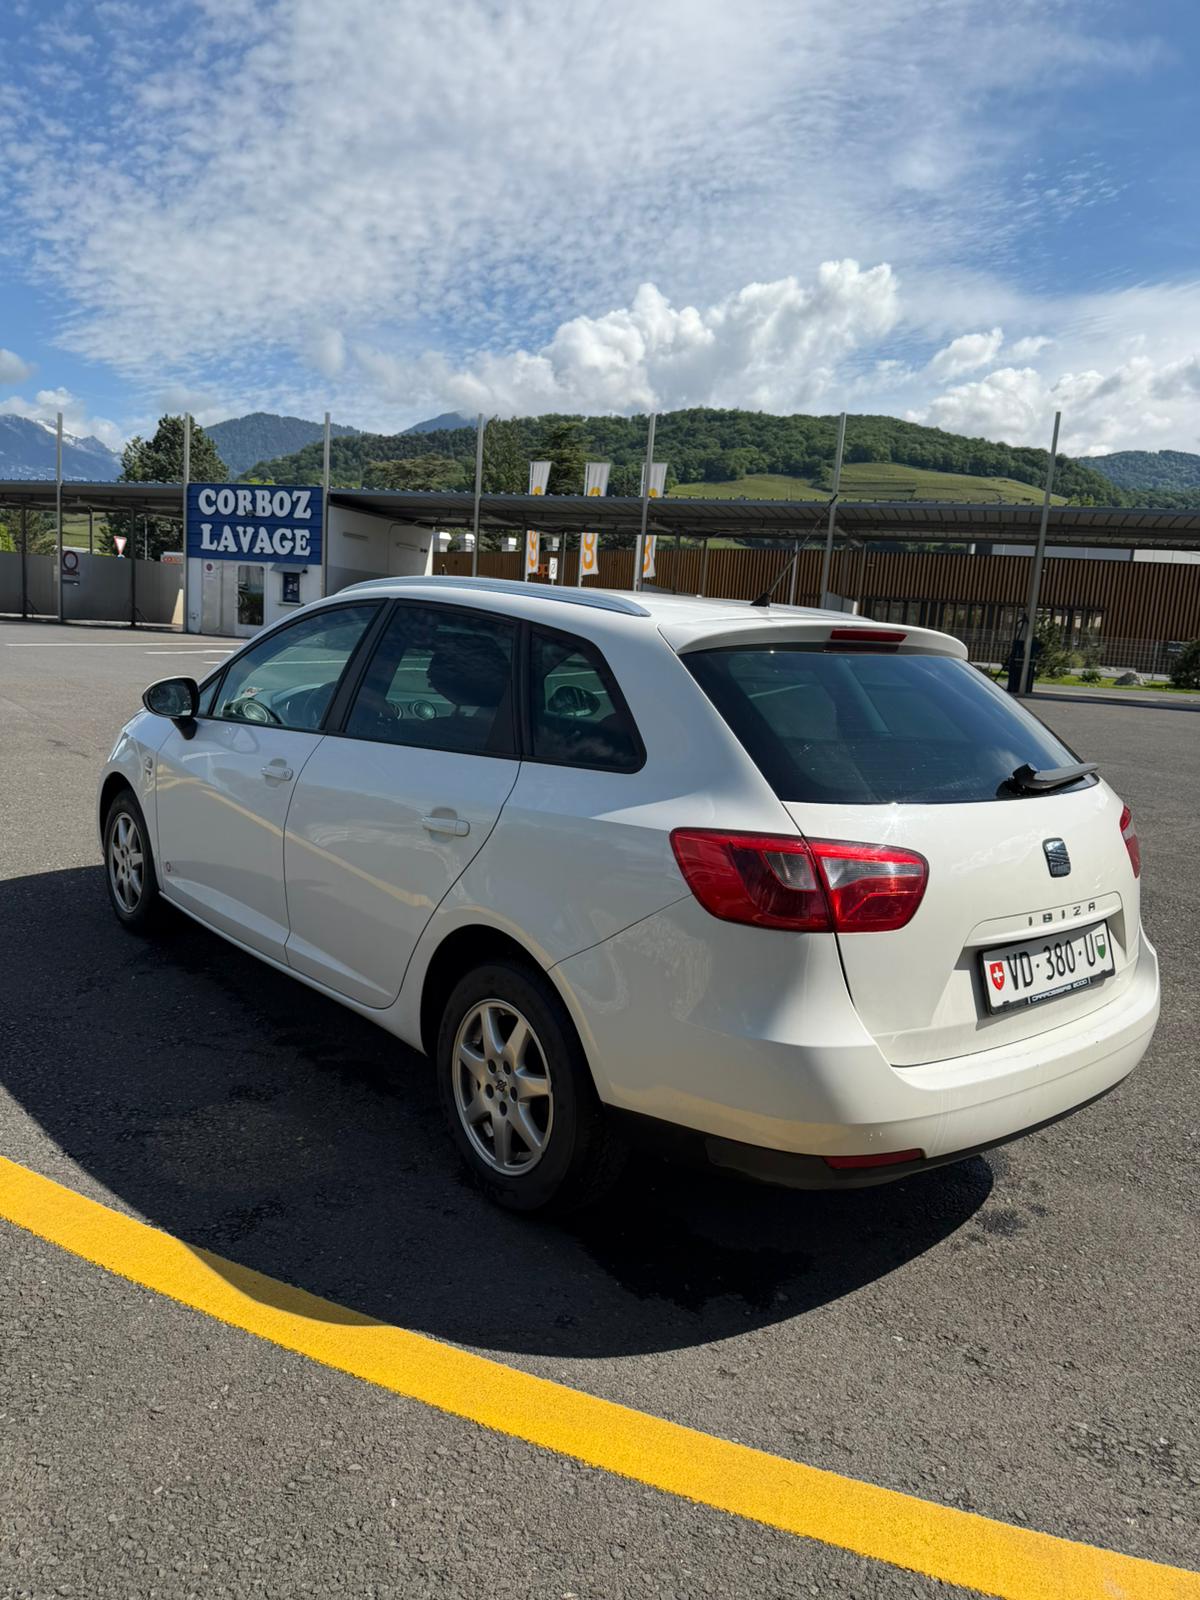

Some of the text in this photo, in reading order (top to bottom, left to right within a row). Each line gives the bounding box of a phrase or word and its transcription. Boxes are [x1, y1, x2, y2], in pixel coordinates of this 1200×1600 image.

[198, 488, 312, 519] CORBOZ
[200, 523, 311, 556] LAVAGE
[1028, 902, 1096, 926] IBIZA
